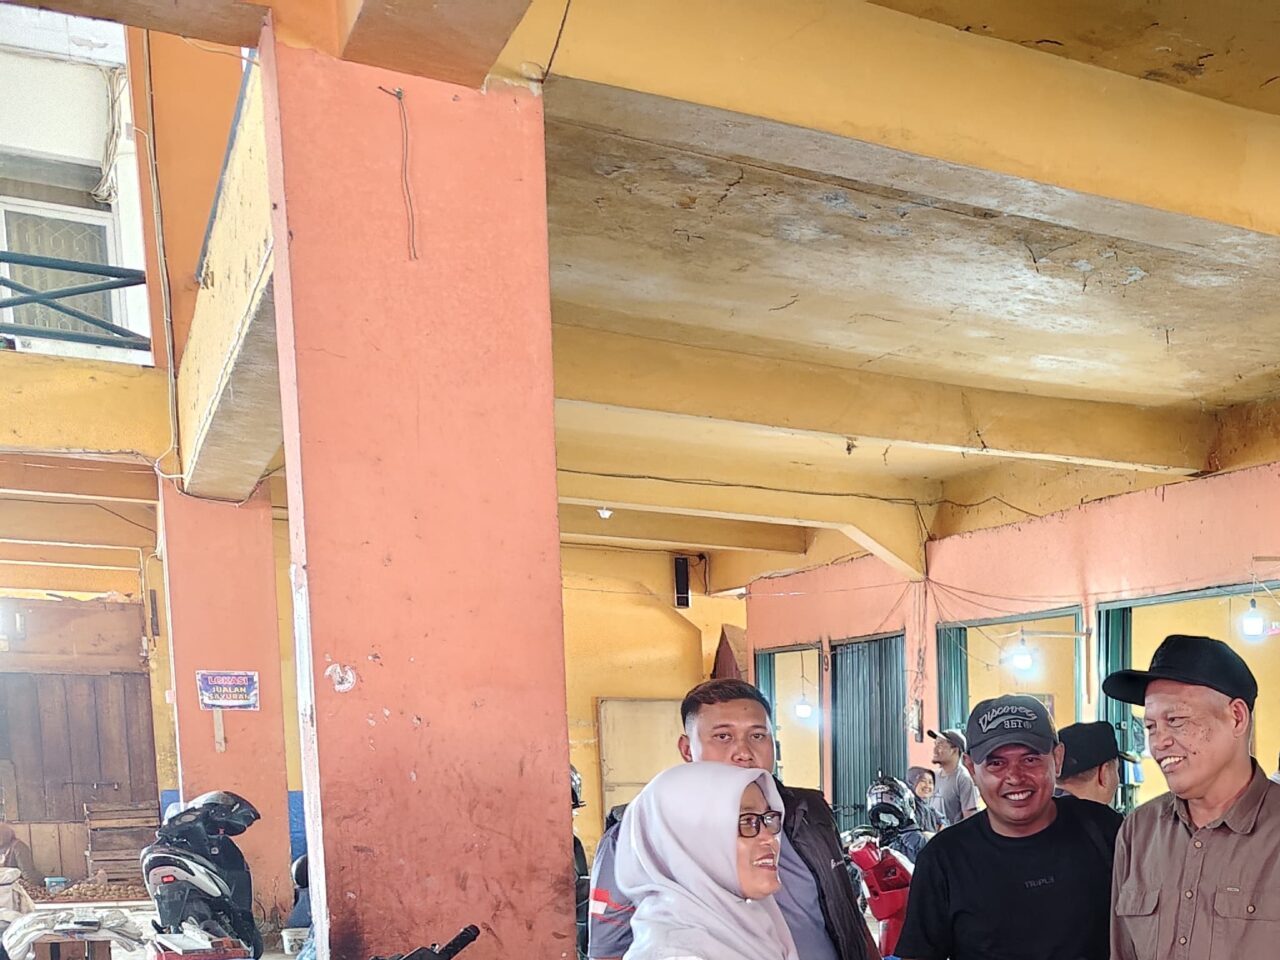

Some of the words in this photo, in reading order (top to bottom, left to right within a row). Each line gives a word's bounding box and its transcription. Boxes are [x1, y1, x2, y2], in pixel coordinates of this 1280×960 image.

[207, 675, 249, 686] LOKASI
[212, 686, 246, 694] JUALAN
[208, 693, 250, 701] SAYURAN
